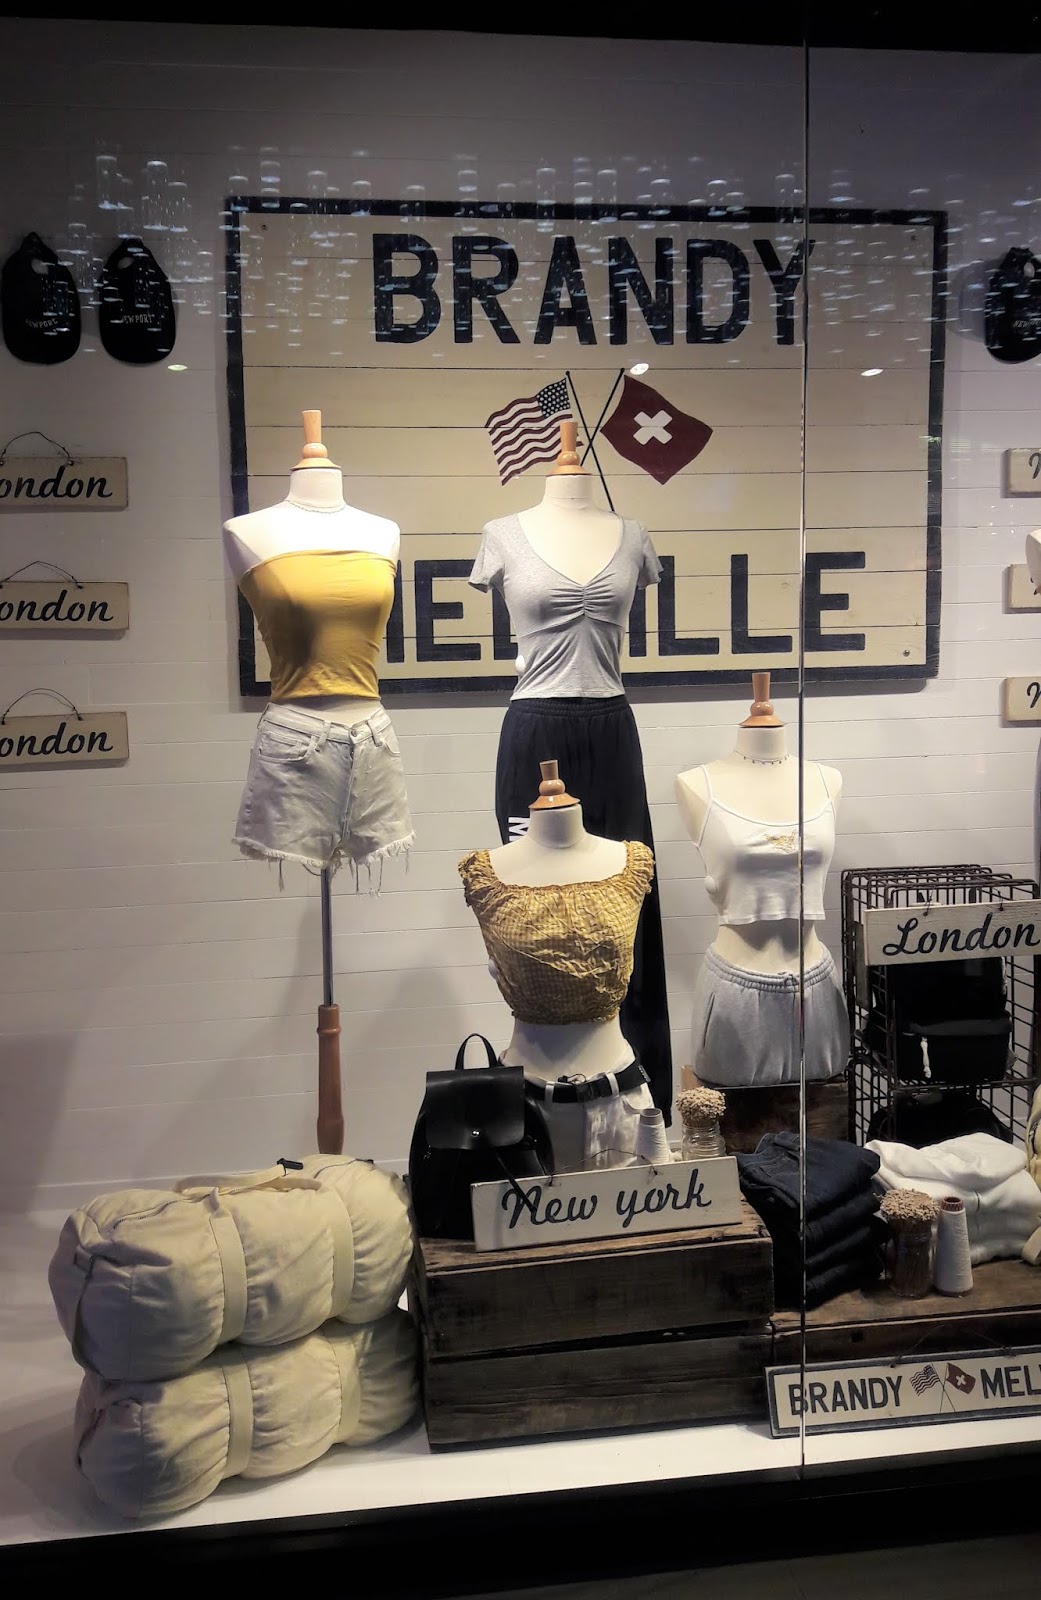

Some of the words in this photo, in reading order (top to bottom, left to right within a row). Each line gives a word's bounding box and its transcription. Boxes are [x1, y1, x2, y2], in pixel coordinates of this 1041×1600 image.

[372, 233, 816, 346] BRANDY
[0, 465, 113, 499] ondon
[0, 589, 113, 622] ondon
[0, 722, 113, 757] ondon
[882, 912, 1041, 956] London
[501, 1185, 598, 1229] New
[788, 1375, 903, 1416] BRANDY
[980, 1363, 1041, 1399] MEL
